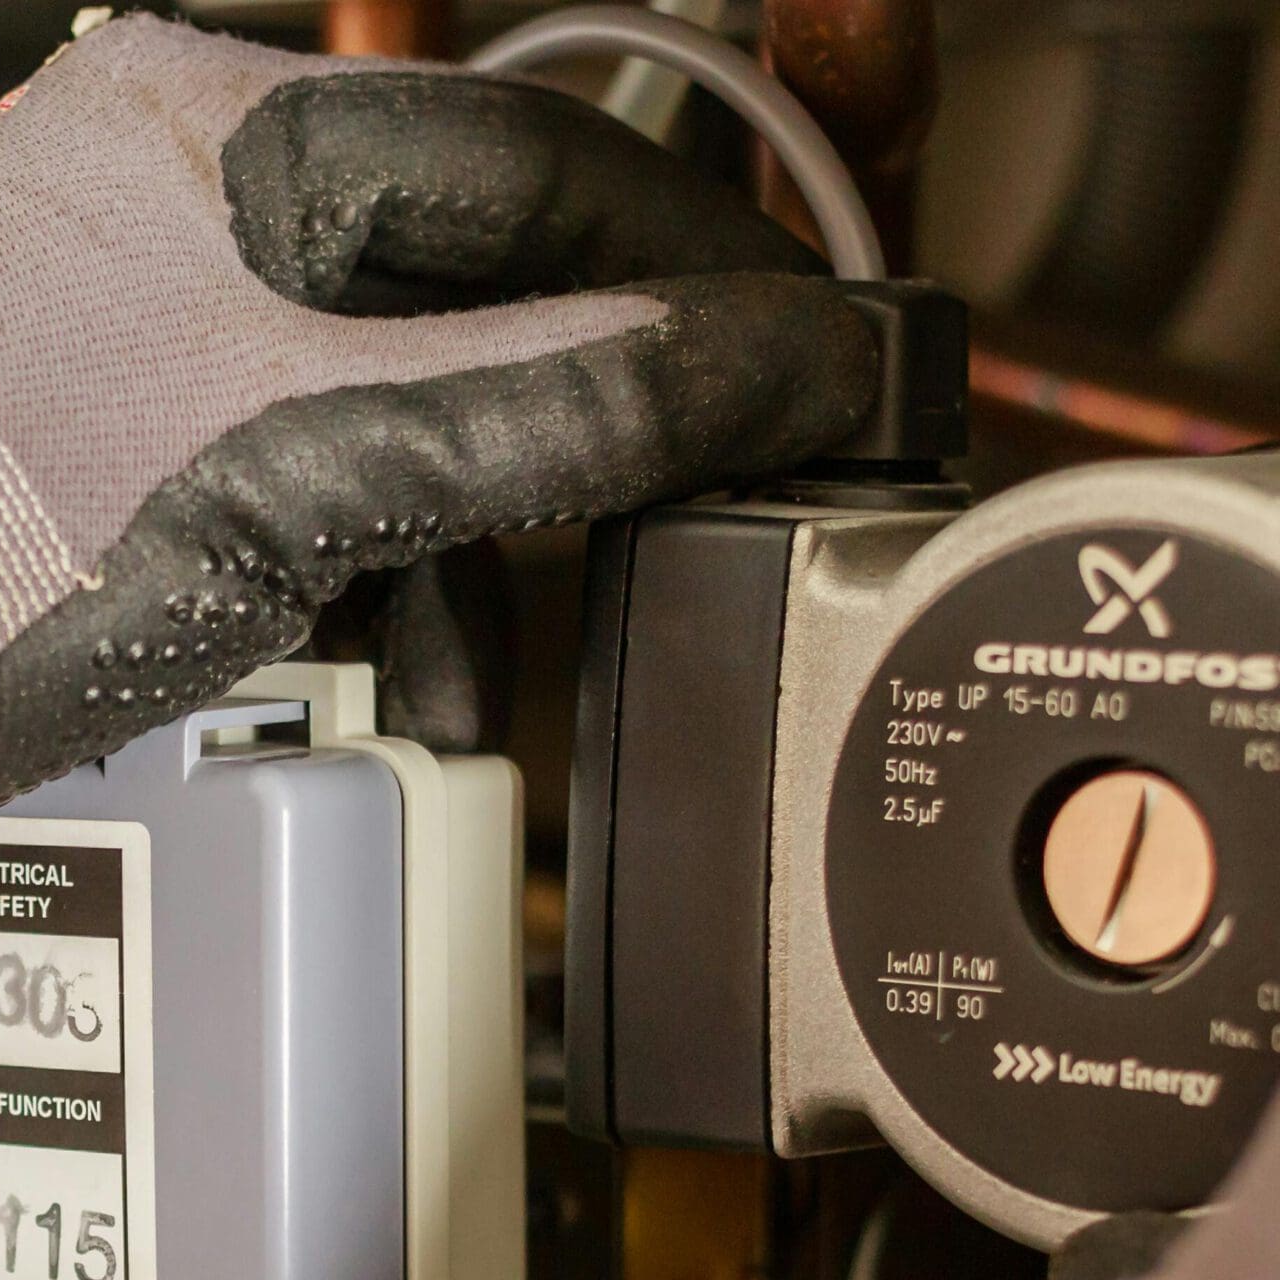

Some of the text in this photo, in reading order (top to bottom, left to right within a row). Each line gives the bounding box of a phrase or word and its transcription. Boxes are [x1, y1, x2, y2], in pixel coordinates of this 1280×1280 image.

[973, 642, 1280, 691] GRUNDFOS
[890, 679, 944, 712] Type
[958, 684, 988, 711] UP
[1003, 686, 1076, 718] 15-60
[885, 758, 939, 786] 50Hz
[886, 988, 984, 1020] 0.39 90
[1058, 1052, 1221, 1107] Low Energy
